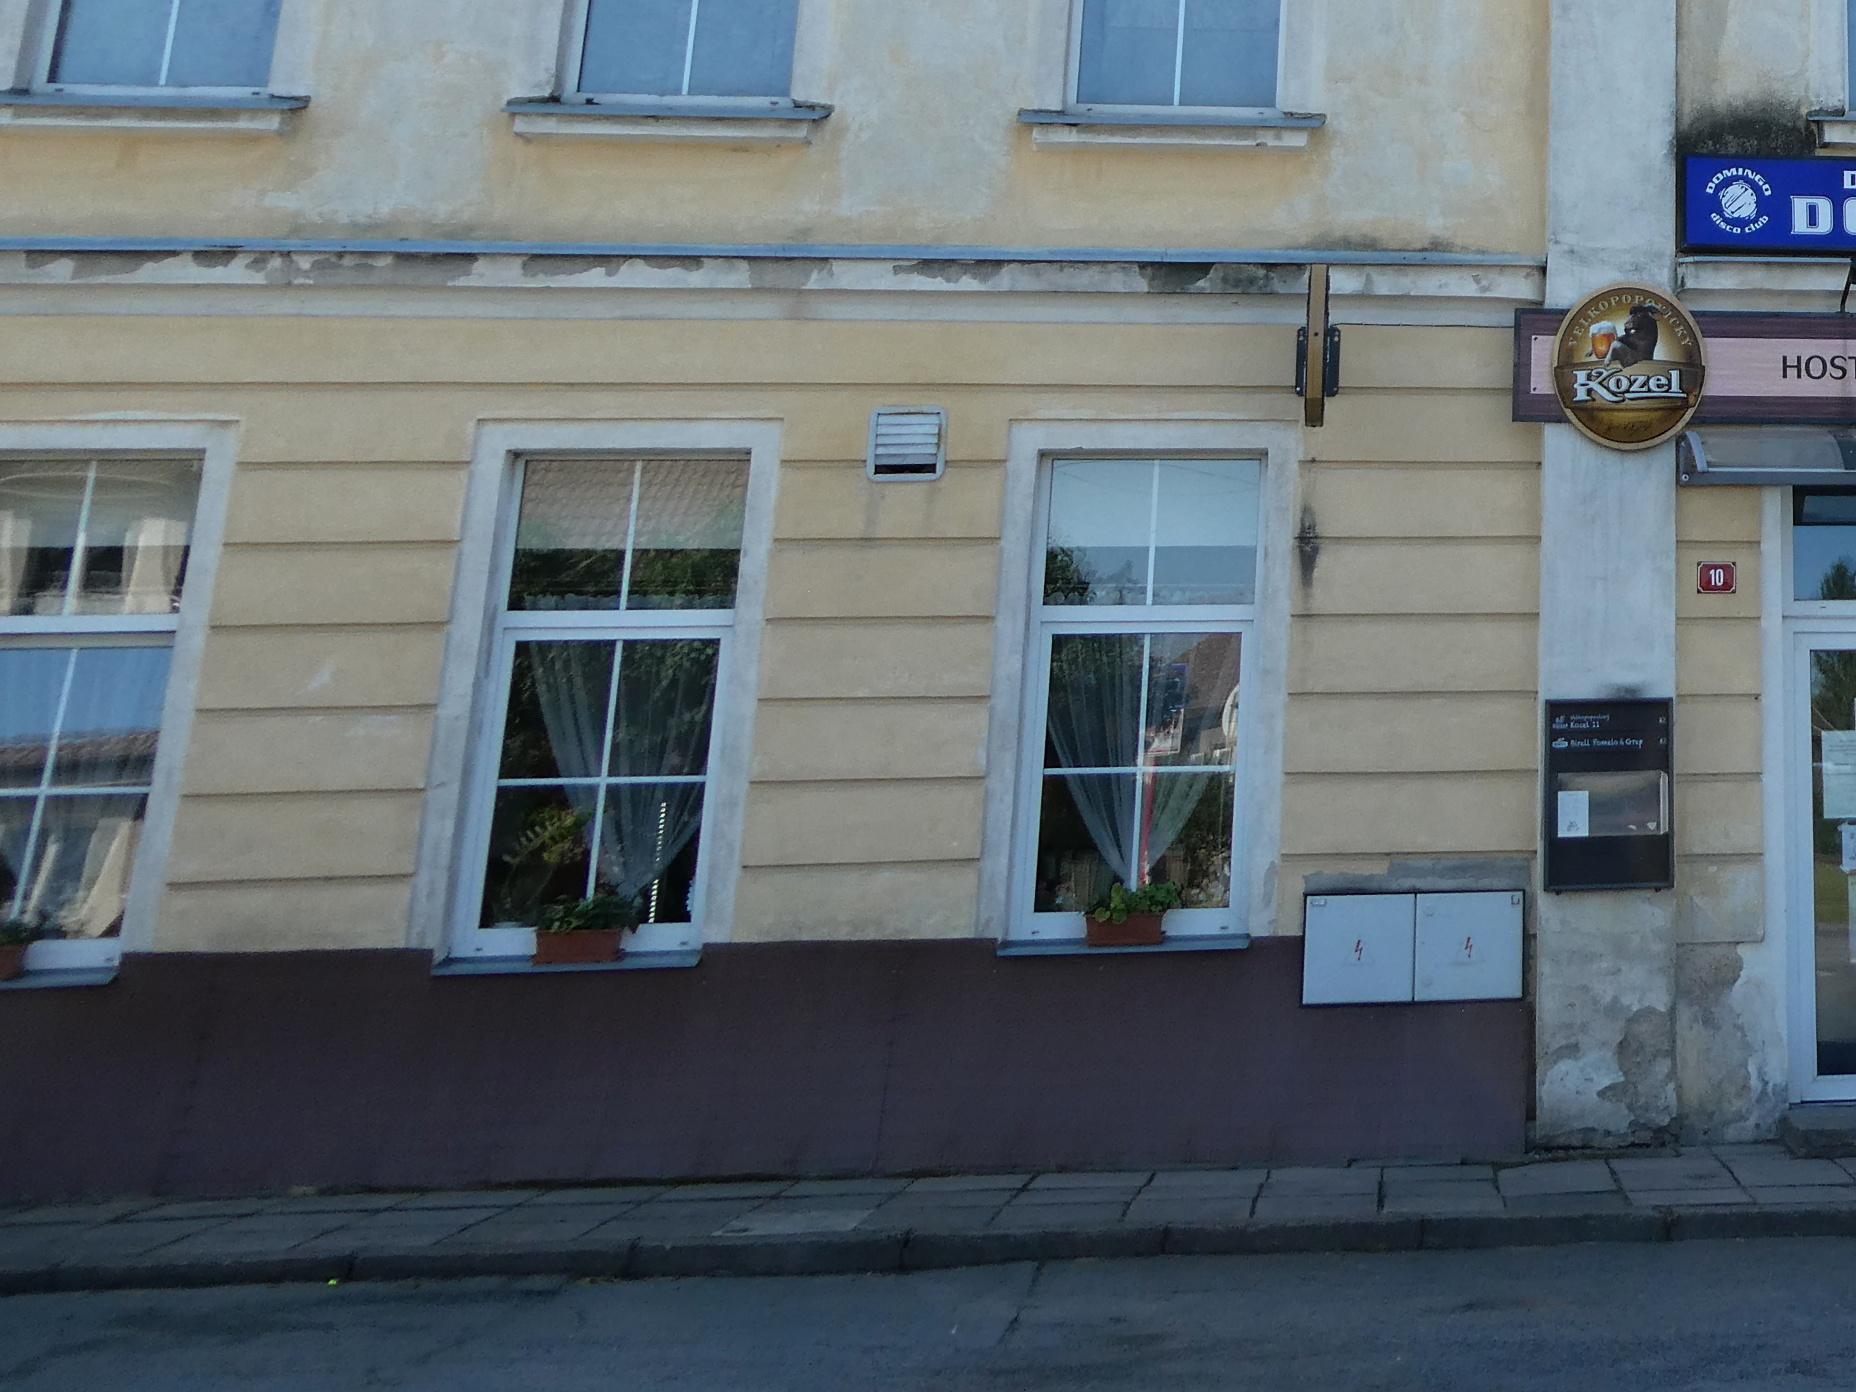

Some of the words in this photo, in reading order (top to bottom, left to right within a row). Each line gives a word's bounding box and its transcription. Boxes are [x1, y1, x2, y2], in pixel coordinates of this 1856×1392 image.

[1705, 167, 1772, 196] DOMINGO
[1710, 211, 1742, 234] disco
[1745, 214, 1769, 234] club
[1572, 367, 1687, 403] Kozel
[1709, 568, 1724, 586] 10
